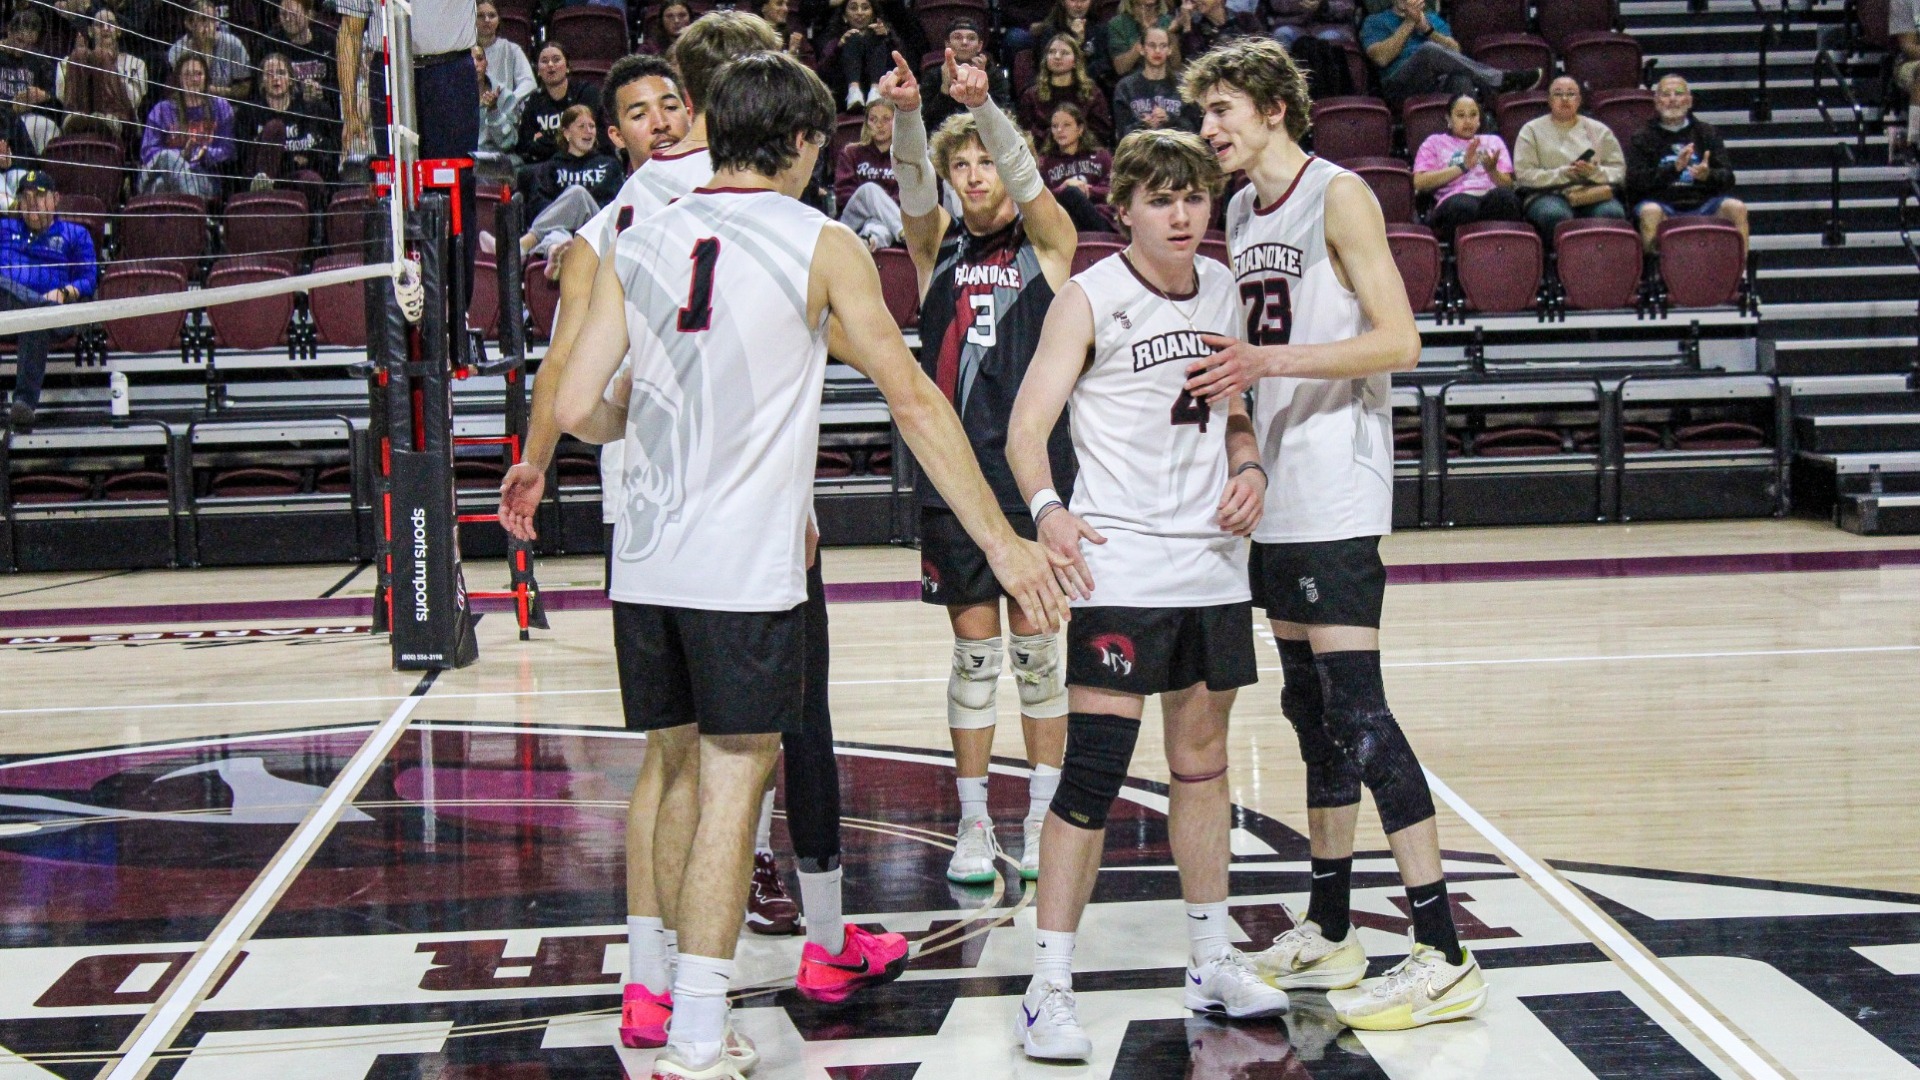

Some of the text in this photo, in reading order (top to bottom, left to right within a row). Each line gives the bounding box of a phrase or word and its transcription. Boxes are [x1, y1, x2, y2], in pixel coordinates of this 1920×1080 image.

[676, 236, 721, 332] 1
[954, 263, 1021, 290] ROANOKE
[1233, 242, 1304, 283] ROANOKE
[966, 293, 997, 348] 3
[1132, 330, 1222, 373] ROANO
[1170, 367, 1211, 433] 4
[410, 508, 428, 622] sports imports
[90, 626, 370, 642] HARLES
